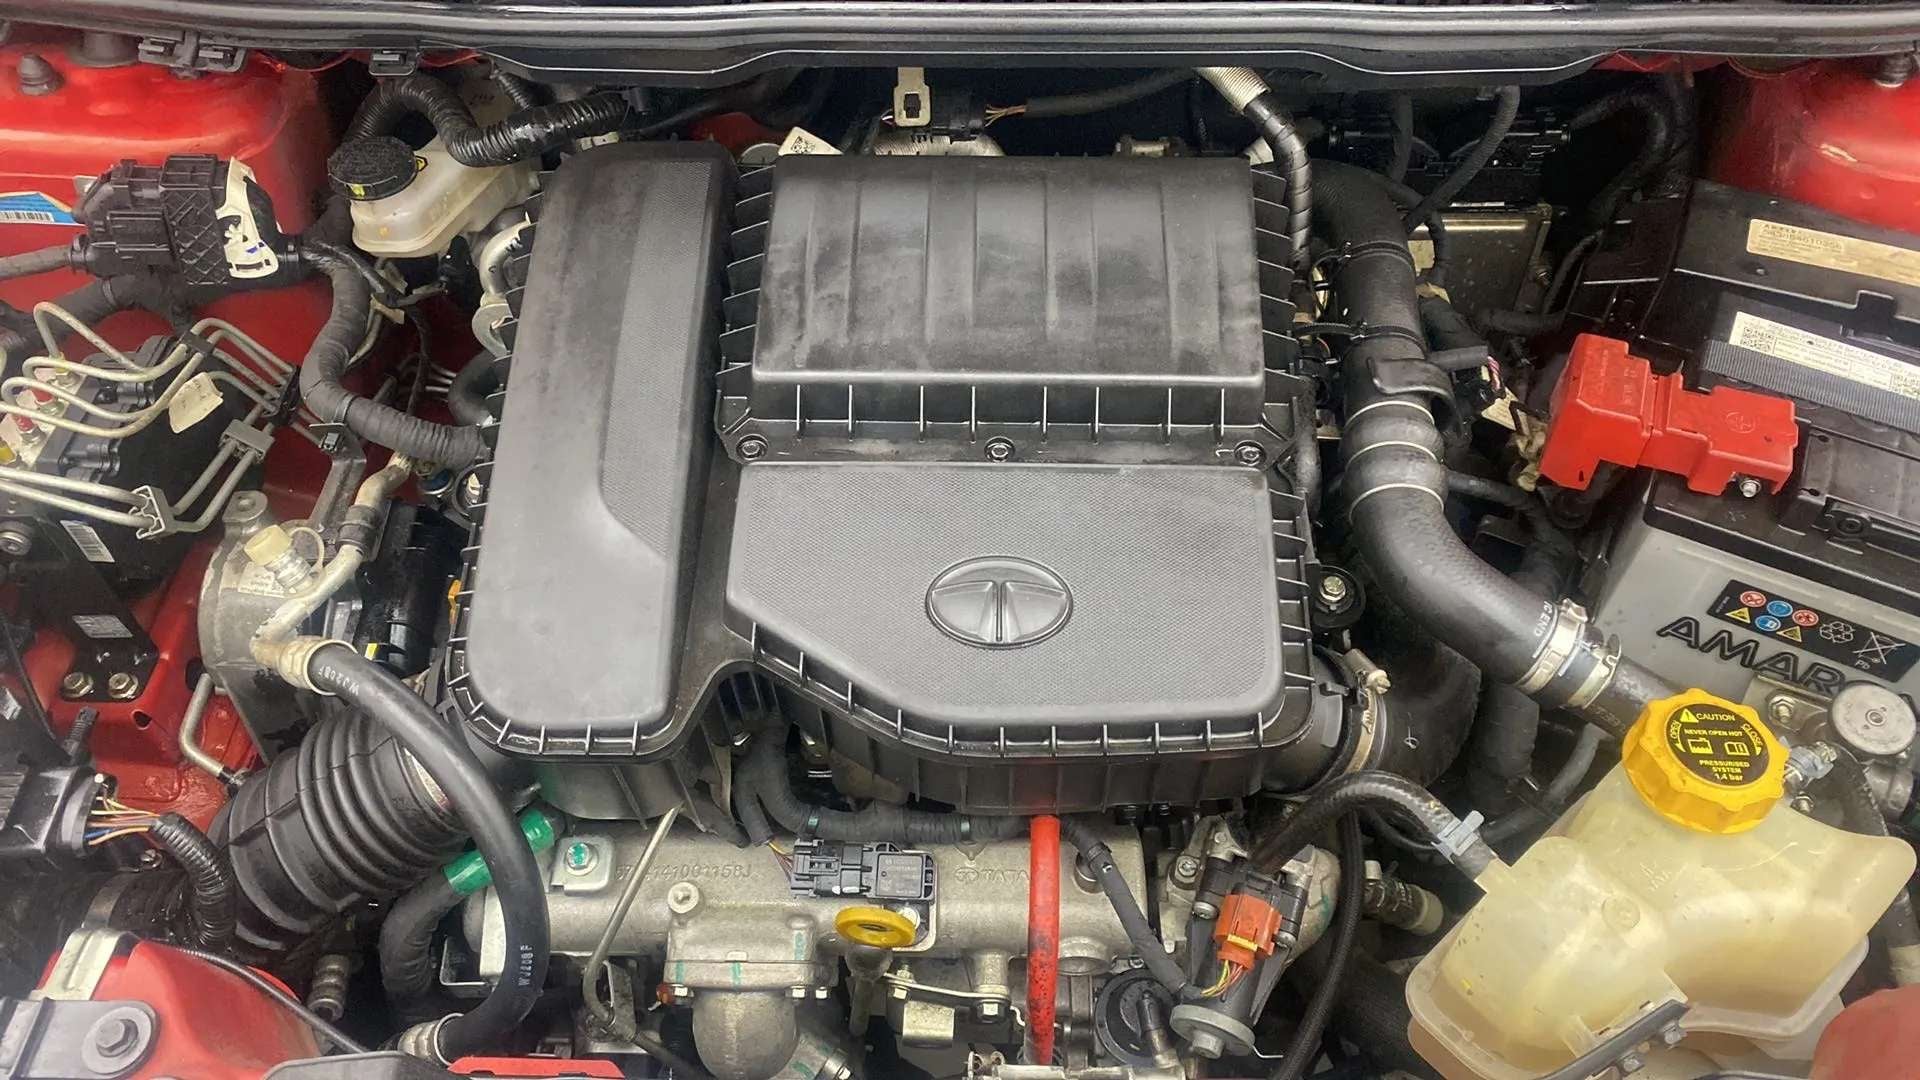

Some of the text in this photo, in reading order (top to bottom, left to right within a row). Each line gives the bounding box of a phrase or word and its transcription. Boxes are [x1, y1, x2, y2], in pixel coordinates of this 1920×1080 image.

[1696, 713, 1736, 722] CAUTION
[1670, 720, 1682, 739] OPEN
[1741, 723, 1764, 747] CLOSE
[1699, 760, 1750, 768] PRESSURISED
[980, 868, 1030, 881] TATA
